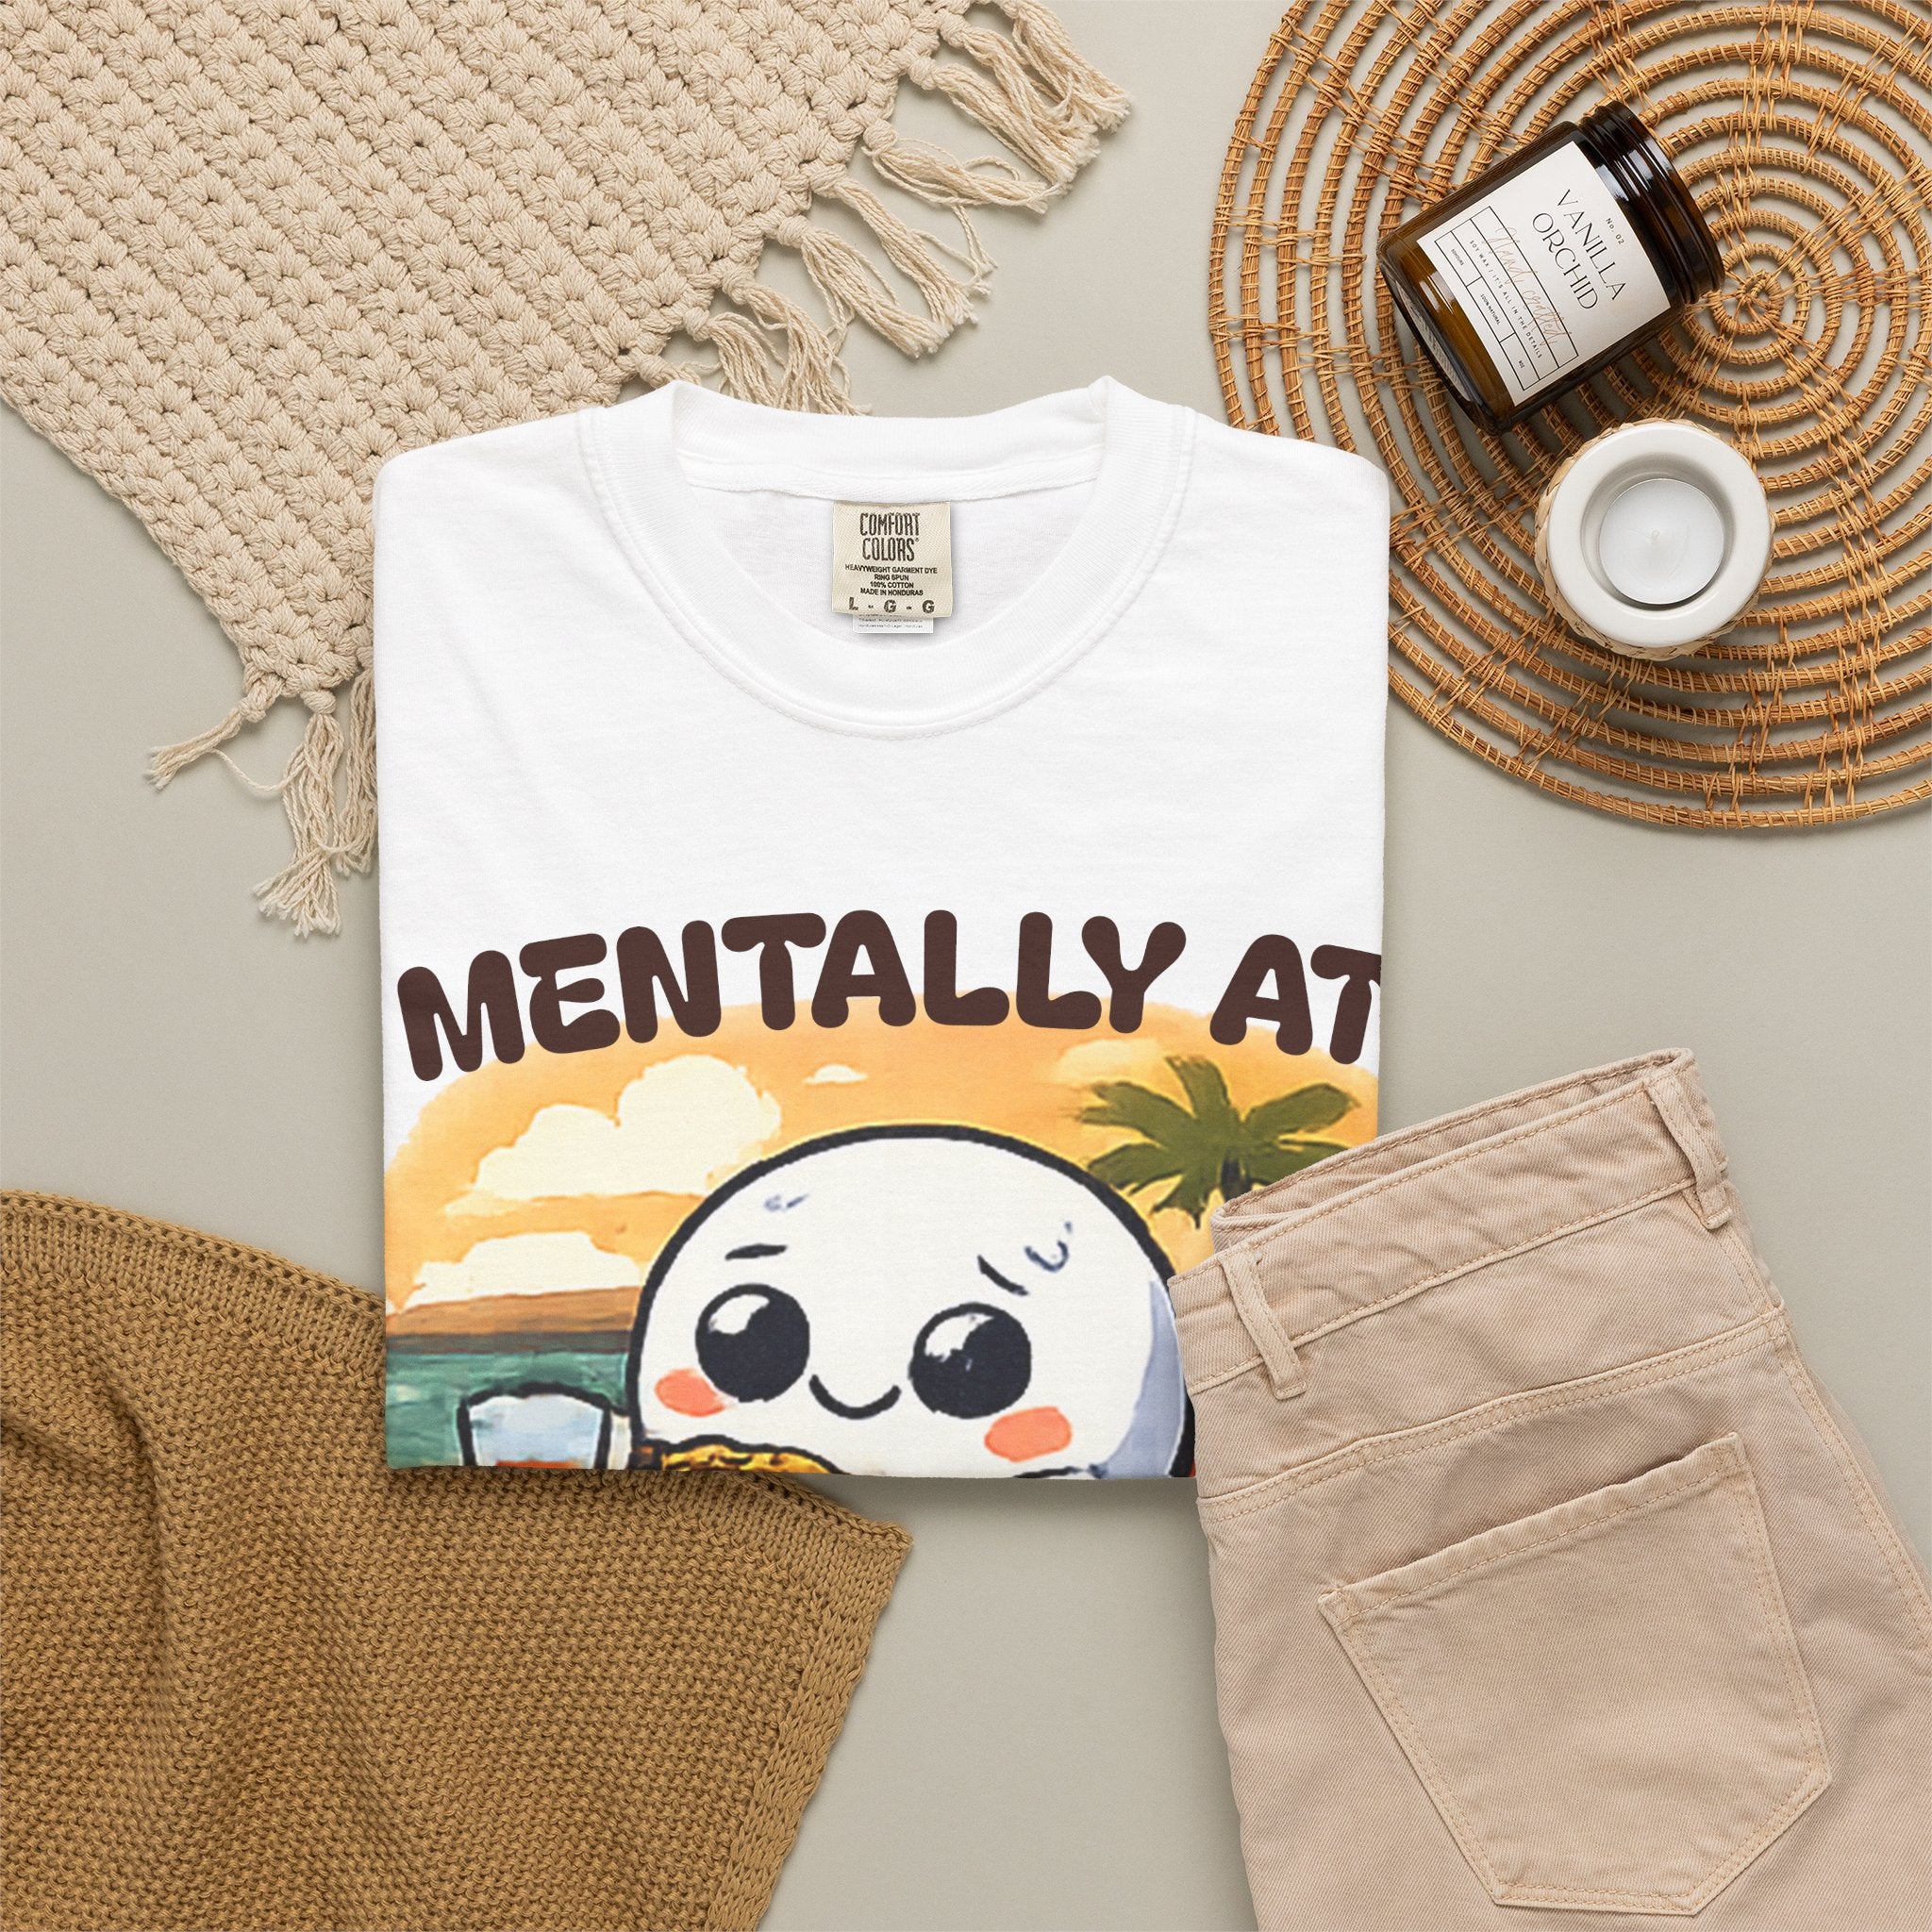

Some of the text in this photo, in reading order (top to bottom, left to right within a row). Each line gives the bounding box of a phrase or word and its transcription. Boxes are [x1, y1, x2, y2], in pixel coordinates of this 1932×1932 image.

[1557, 189, 1627, 302] VANILLA
[1605, 217, 1625, 246] No. 02
[1532, 212, 1599, 310] ORCHID
[1469, 239, 1480, 253] SOY
[1478, 253, 1491, 268] WAX
[1491, 274, 1505, 290] IT'S
[1502, 291, 1512, 305] ALL
[1510, 305, 1519, 315] IN
[1517, 315, 1528, 331] THE
[1524, 331, 1543, 359] DETAILS
[1487, 305, 1502, 326] NATURAL
[859, 512, 920, 536] COMFORT
[844, 564, 891, 573] HEAVYWEIGHT
[891, 566, 924, 575] GARMENT
[848, 596, 859, 610] L
[883, 599, 896, 613] G
[922, 599, 935, 613] G
[397, 910, 1382, 1082] MENTALLY AT
